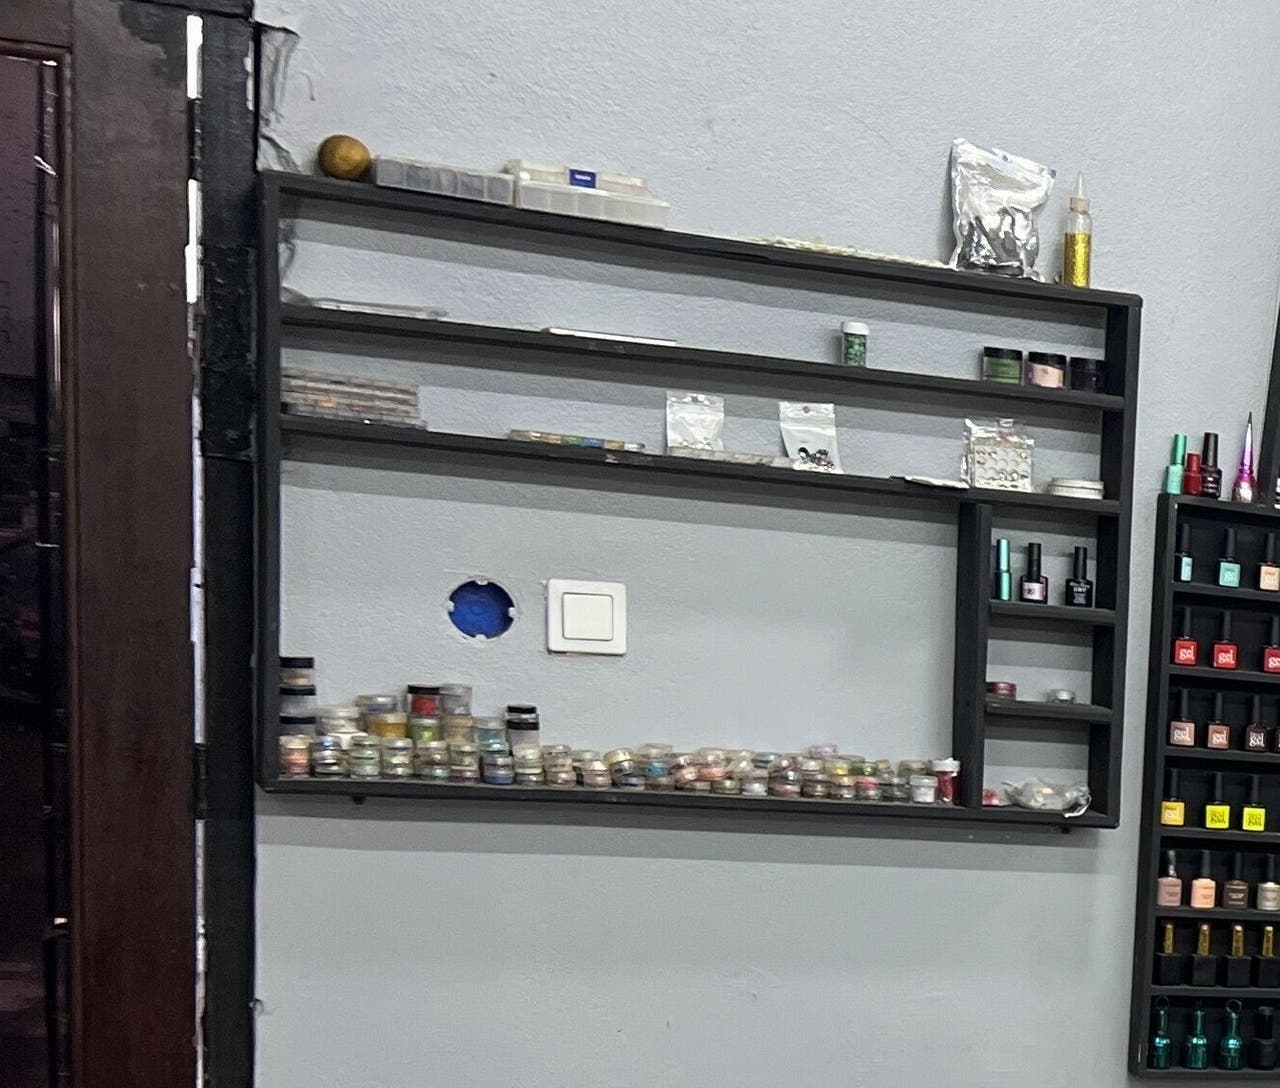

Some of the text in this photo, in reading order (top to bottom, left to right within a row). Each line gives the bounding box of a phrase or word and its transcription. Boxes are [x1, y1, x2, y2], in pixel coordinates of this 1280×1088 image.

[1179, 646, 1195, 660] gel
[1218, 649, 1235, 664] gel
[1173, 727, 1191, 741] gel
[1212, 731, 1227, 744] gel
[1250, 733, 1265, 747] gel
